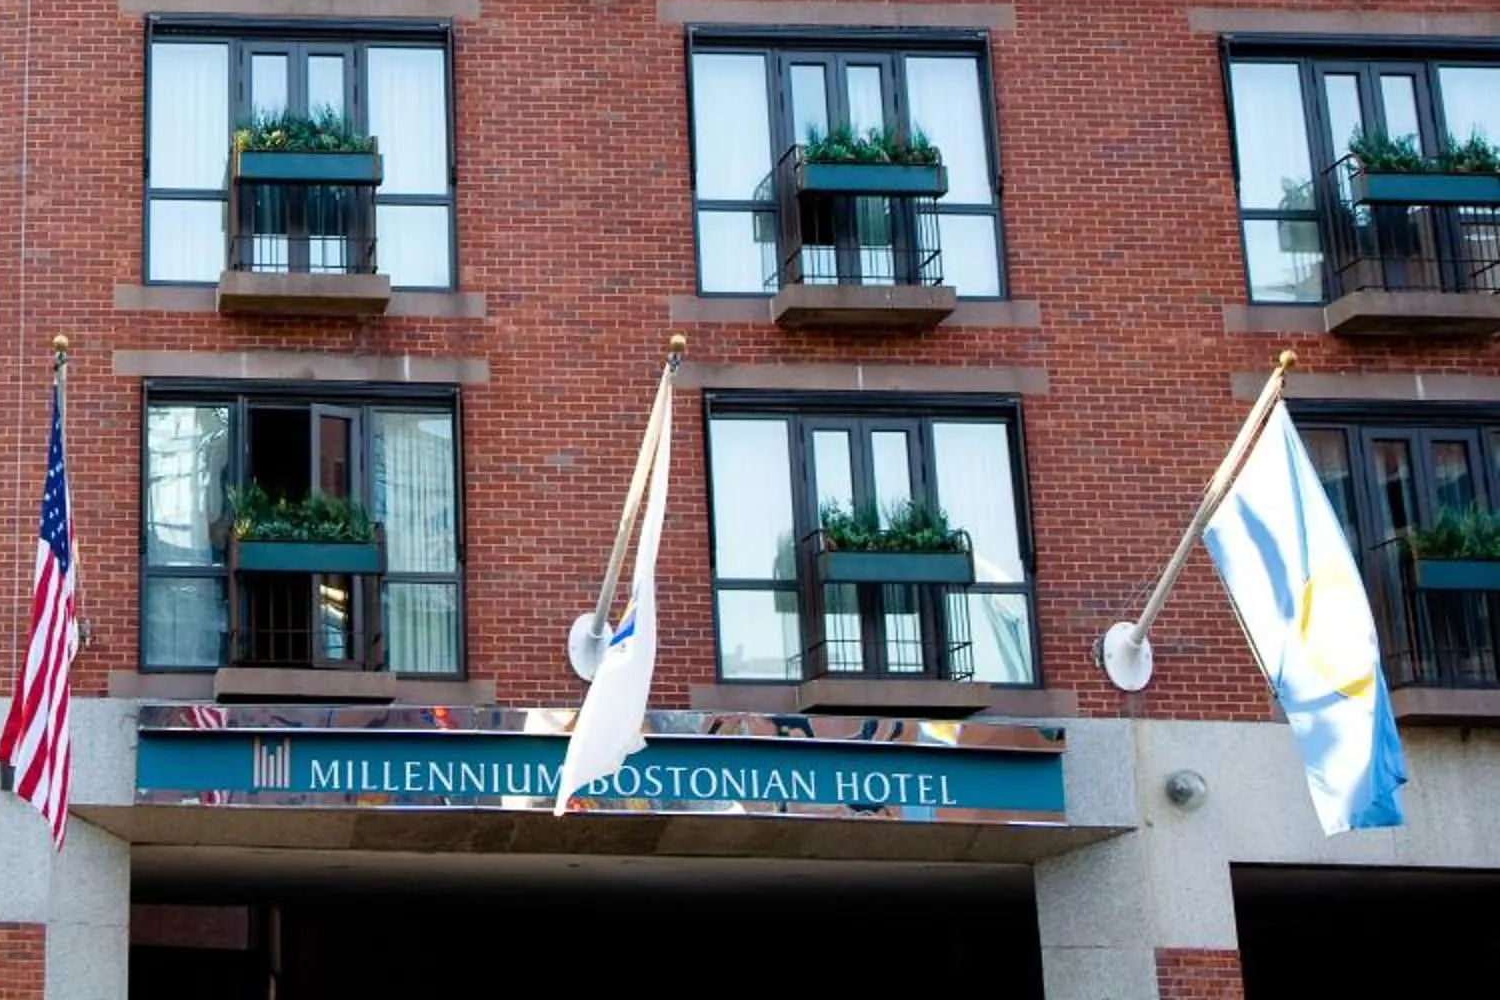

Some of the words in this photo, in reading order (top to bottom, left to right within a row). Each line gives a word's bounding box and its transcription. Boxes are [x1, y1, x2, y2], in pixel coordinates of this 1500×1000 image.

[309, 759, 565, 795] MILLENNIUM
[588, 764, 816, 802] BOSTONIAN
[837, 771, 957, 805] HOTEL
